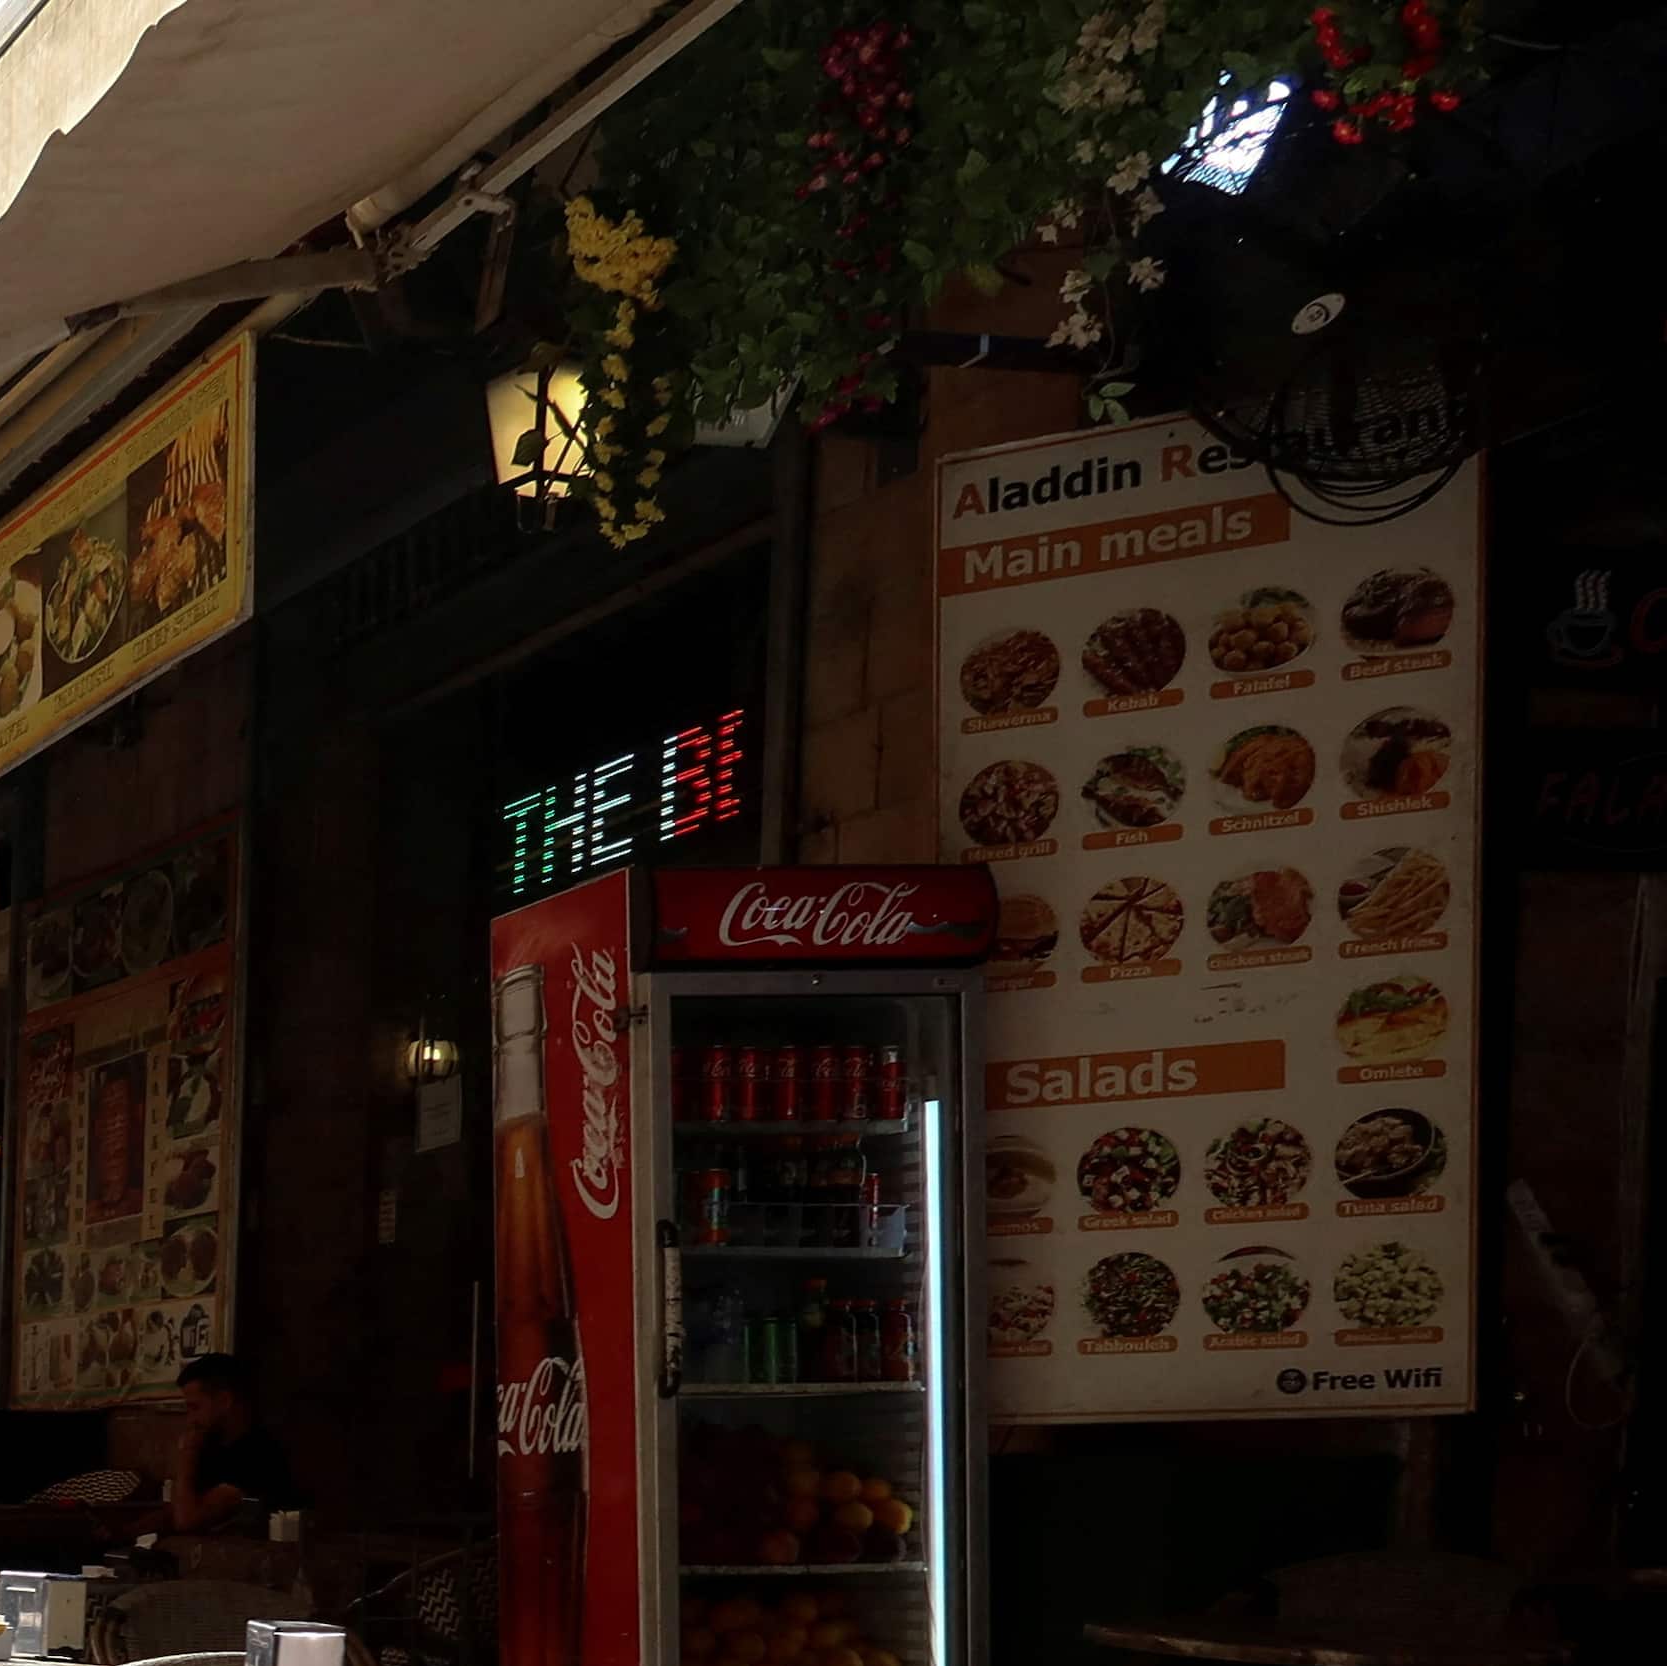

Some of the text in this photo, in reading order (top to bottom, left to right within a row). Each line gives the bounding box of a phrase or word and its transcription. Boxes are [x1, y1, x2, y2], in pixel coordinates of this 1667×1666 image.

[953, 456, 1141, 519] Aladdin
[965, 503, 1252, 583] Main meals
[1350, 660, 1389, 679] Beef
[1234, 675, 1291, 696] Falafel
[1107, 694, 1160, 713] Kebab
[504, 754, 635, 893] THE
[1222, 811, 1300, 833] Schnitzel
[1115, 830, 1148, 846] Fish
[1018, 841, 1051, 861] grill
[719, 881, 920, 947] Coca-Cola
[1346, 936, 1398, 954] French
[1110, 965, 1152, 980] Pizza
[571, 942, 620, 1220] Coca-Cola
[1005, 1051, 1199, 1104] Salads
[1360, 1065, 1425, 1081] Omlete
[1339, 1198, 1438, 1216] Tuna salad
[1083, 1214, 1127, 1230] Greek
[1312, 1366, 1443, 1391] Free Wifi
[497, 1356, 586, 1457] a-Cola
